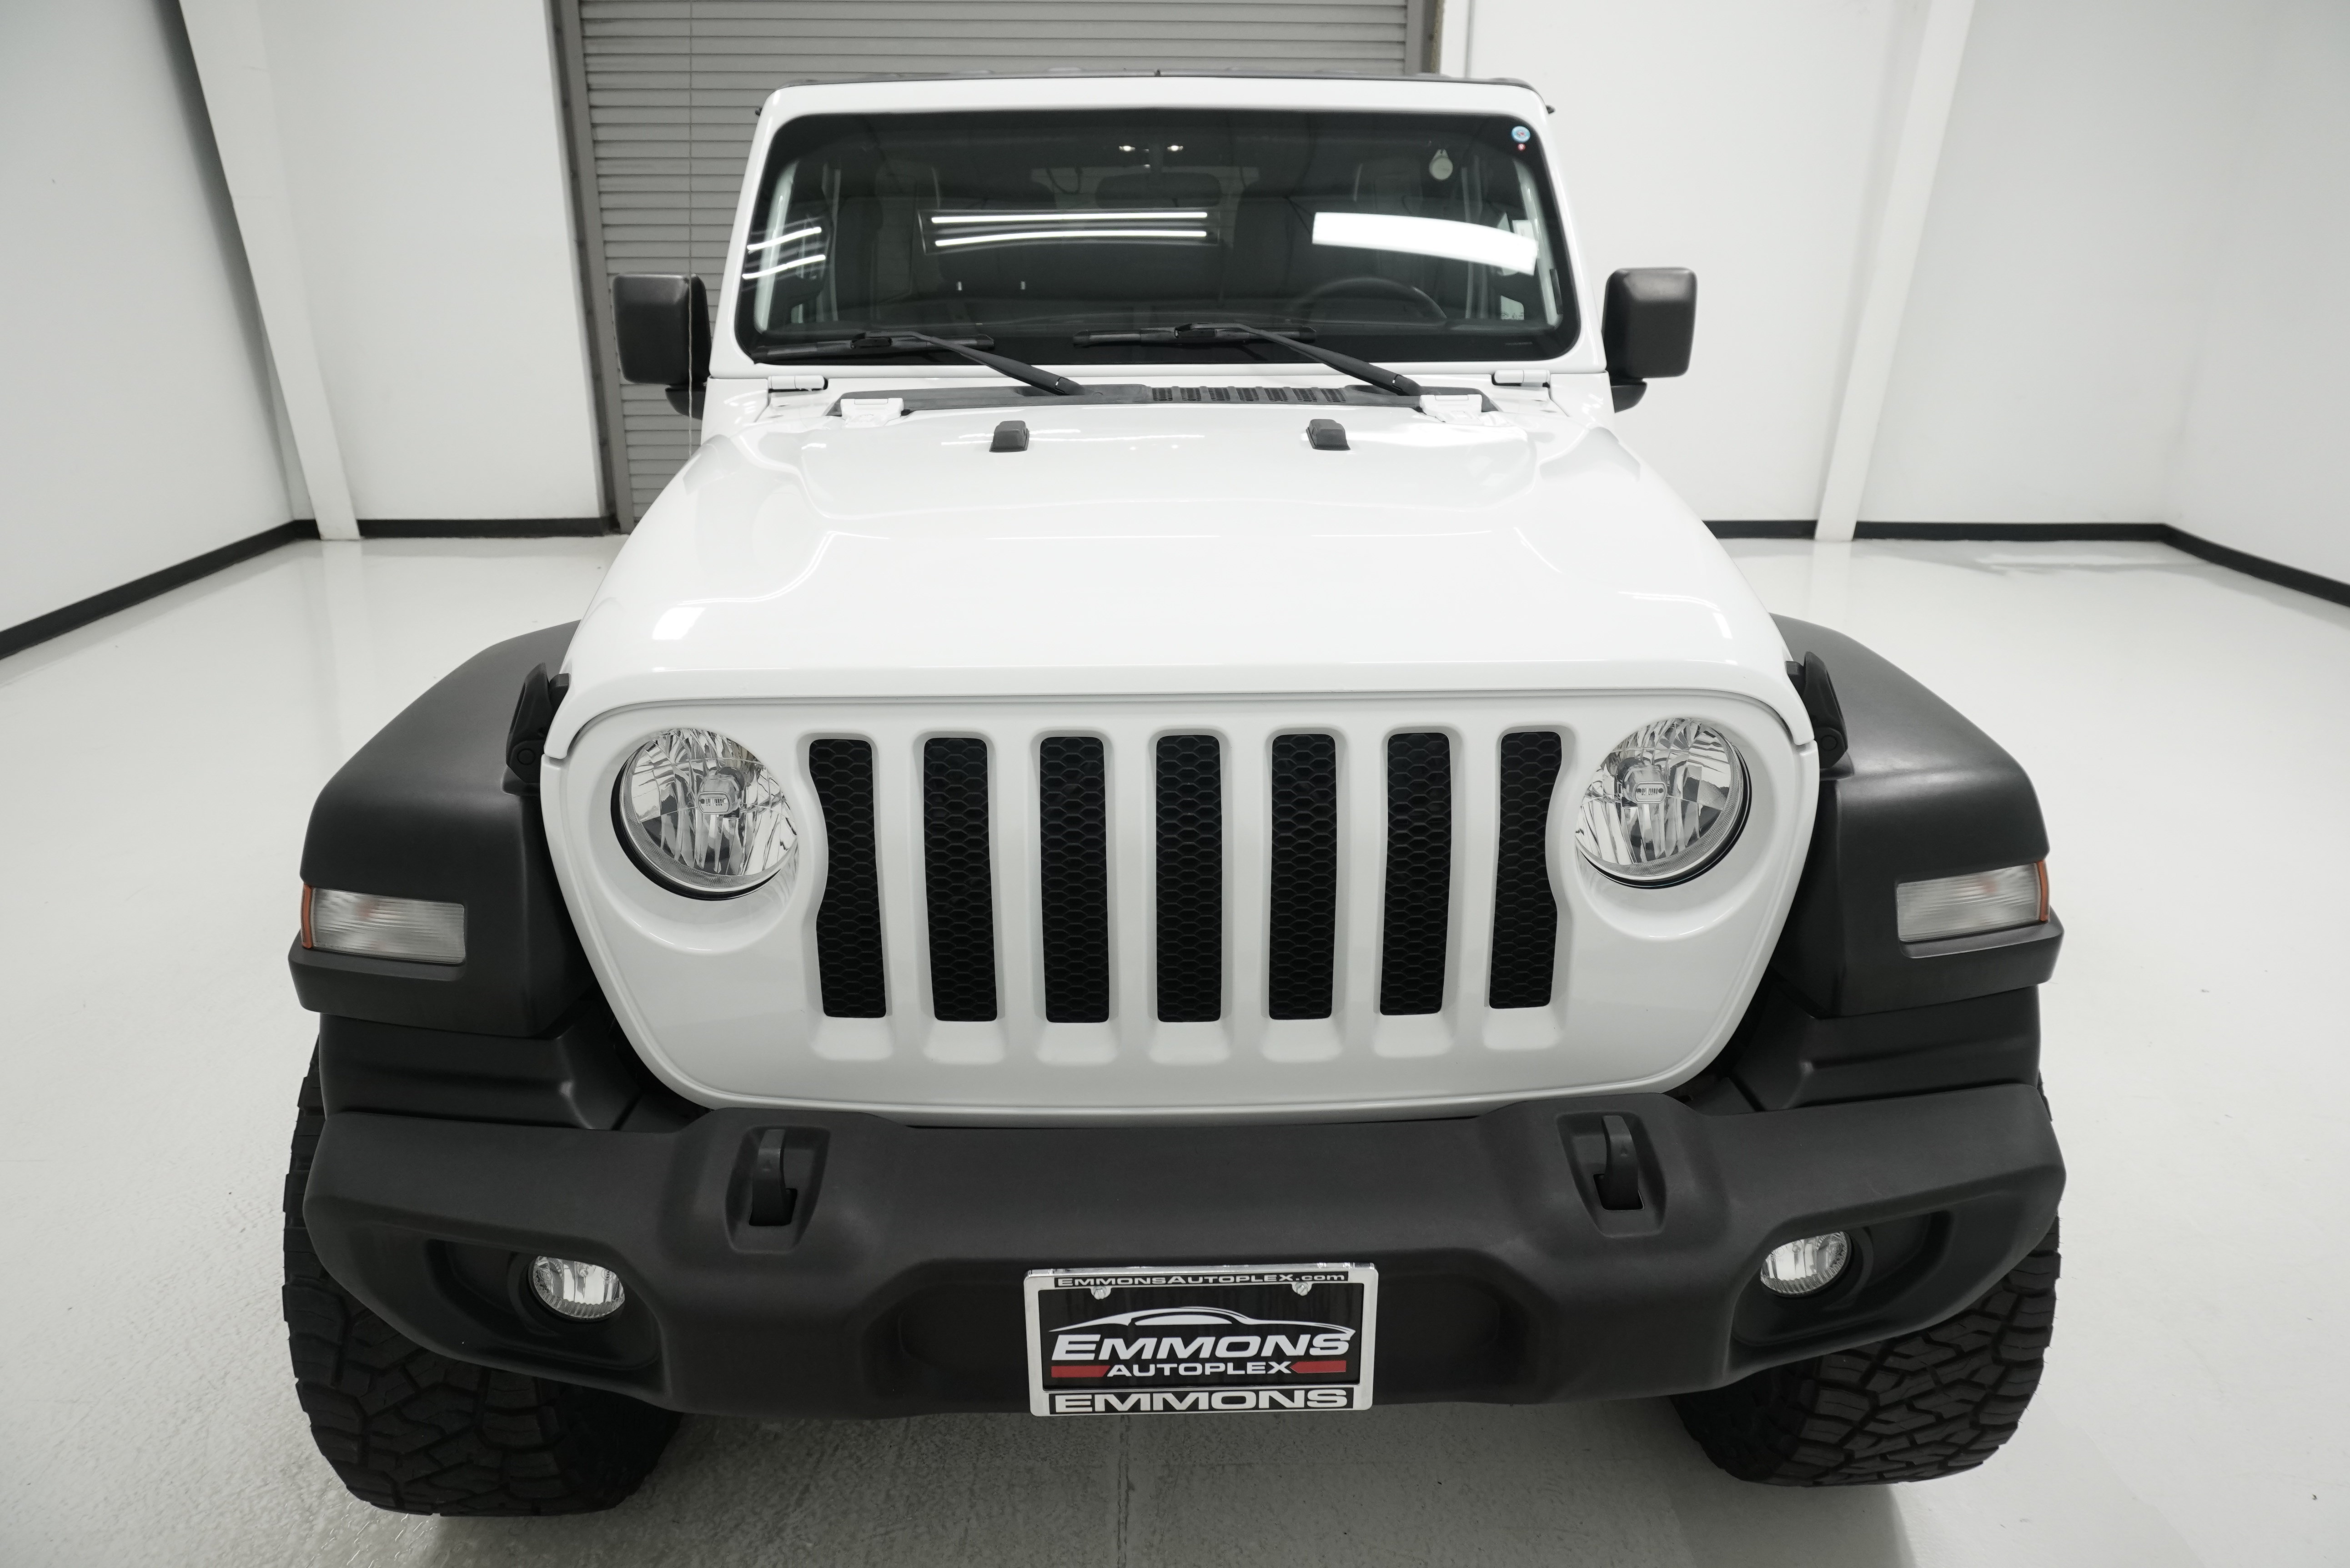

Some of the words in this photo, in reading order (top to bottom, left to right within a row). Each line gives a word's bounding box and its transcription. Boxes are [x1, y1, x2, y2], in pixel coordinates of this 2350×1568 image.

[1051, 1333, 1350, 1361] EMMONS
[1107, 1361, 1292, 1377] AUTOPLEX
[1055, 1389, 1348, 1413] EMMONS
